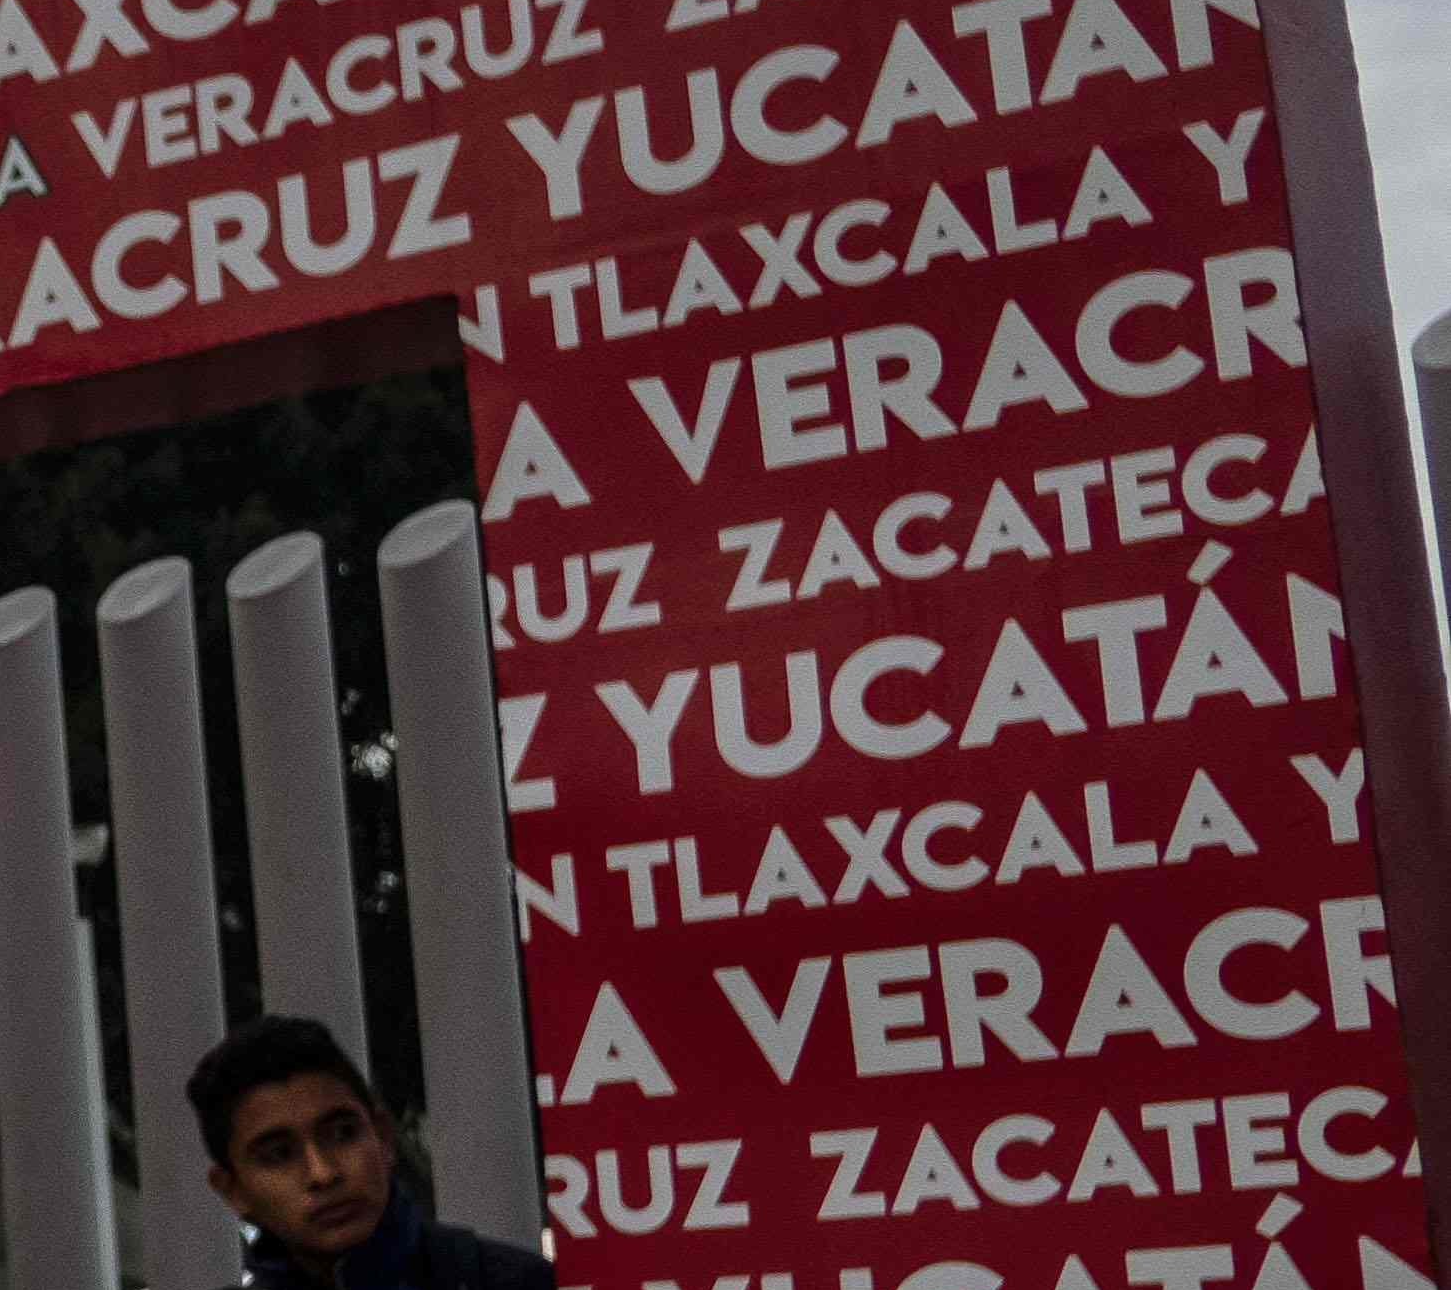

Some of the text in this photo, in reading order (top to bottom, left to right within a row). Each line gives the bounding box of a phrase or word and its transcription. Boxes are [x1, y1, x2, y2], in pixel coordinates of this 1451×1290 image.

[529, 147, 1152, 349] TLAXCALA
[606, 769, 1257, 927] TLAXCALA
[810, 1087, 1419, 1219] ZACATEC
